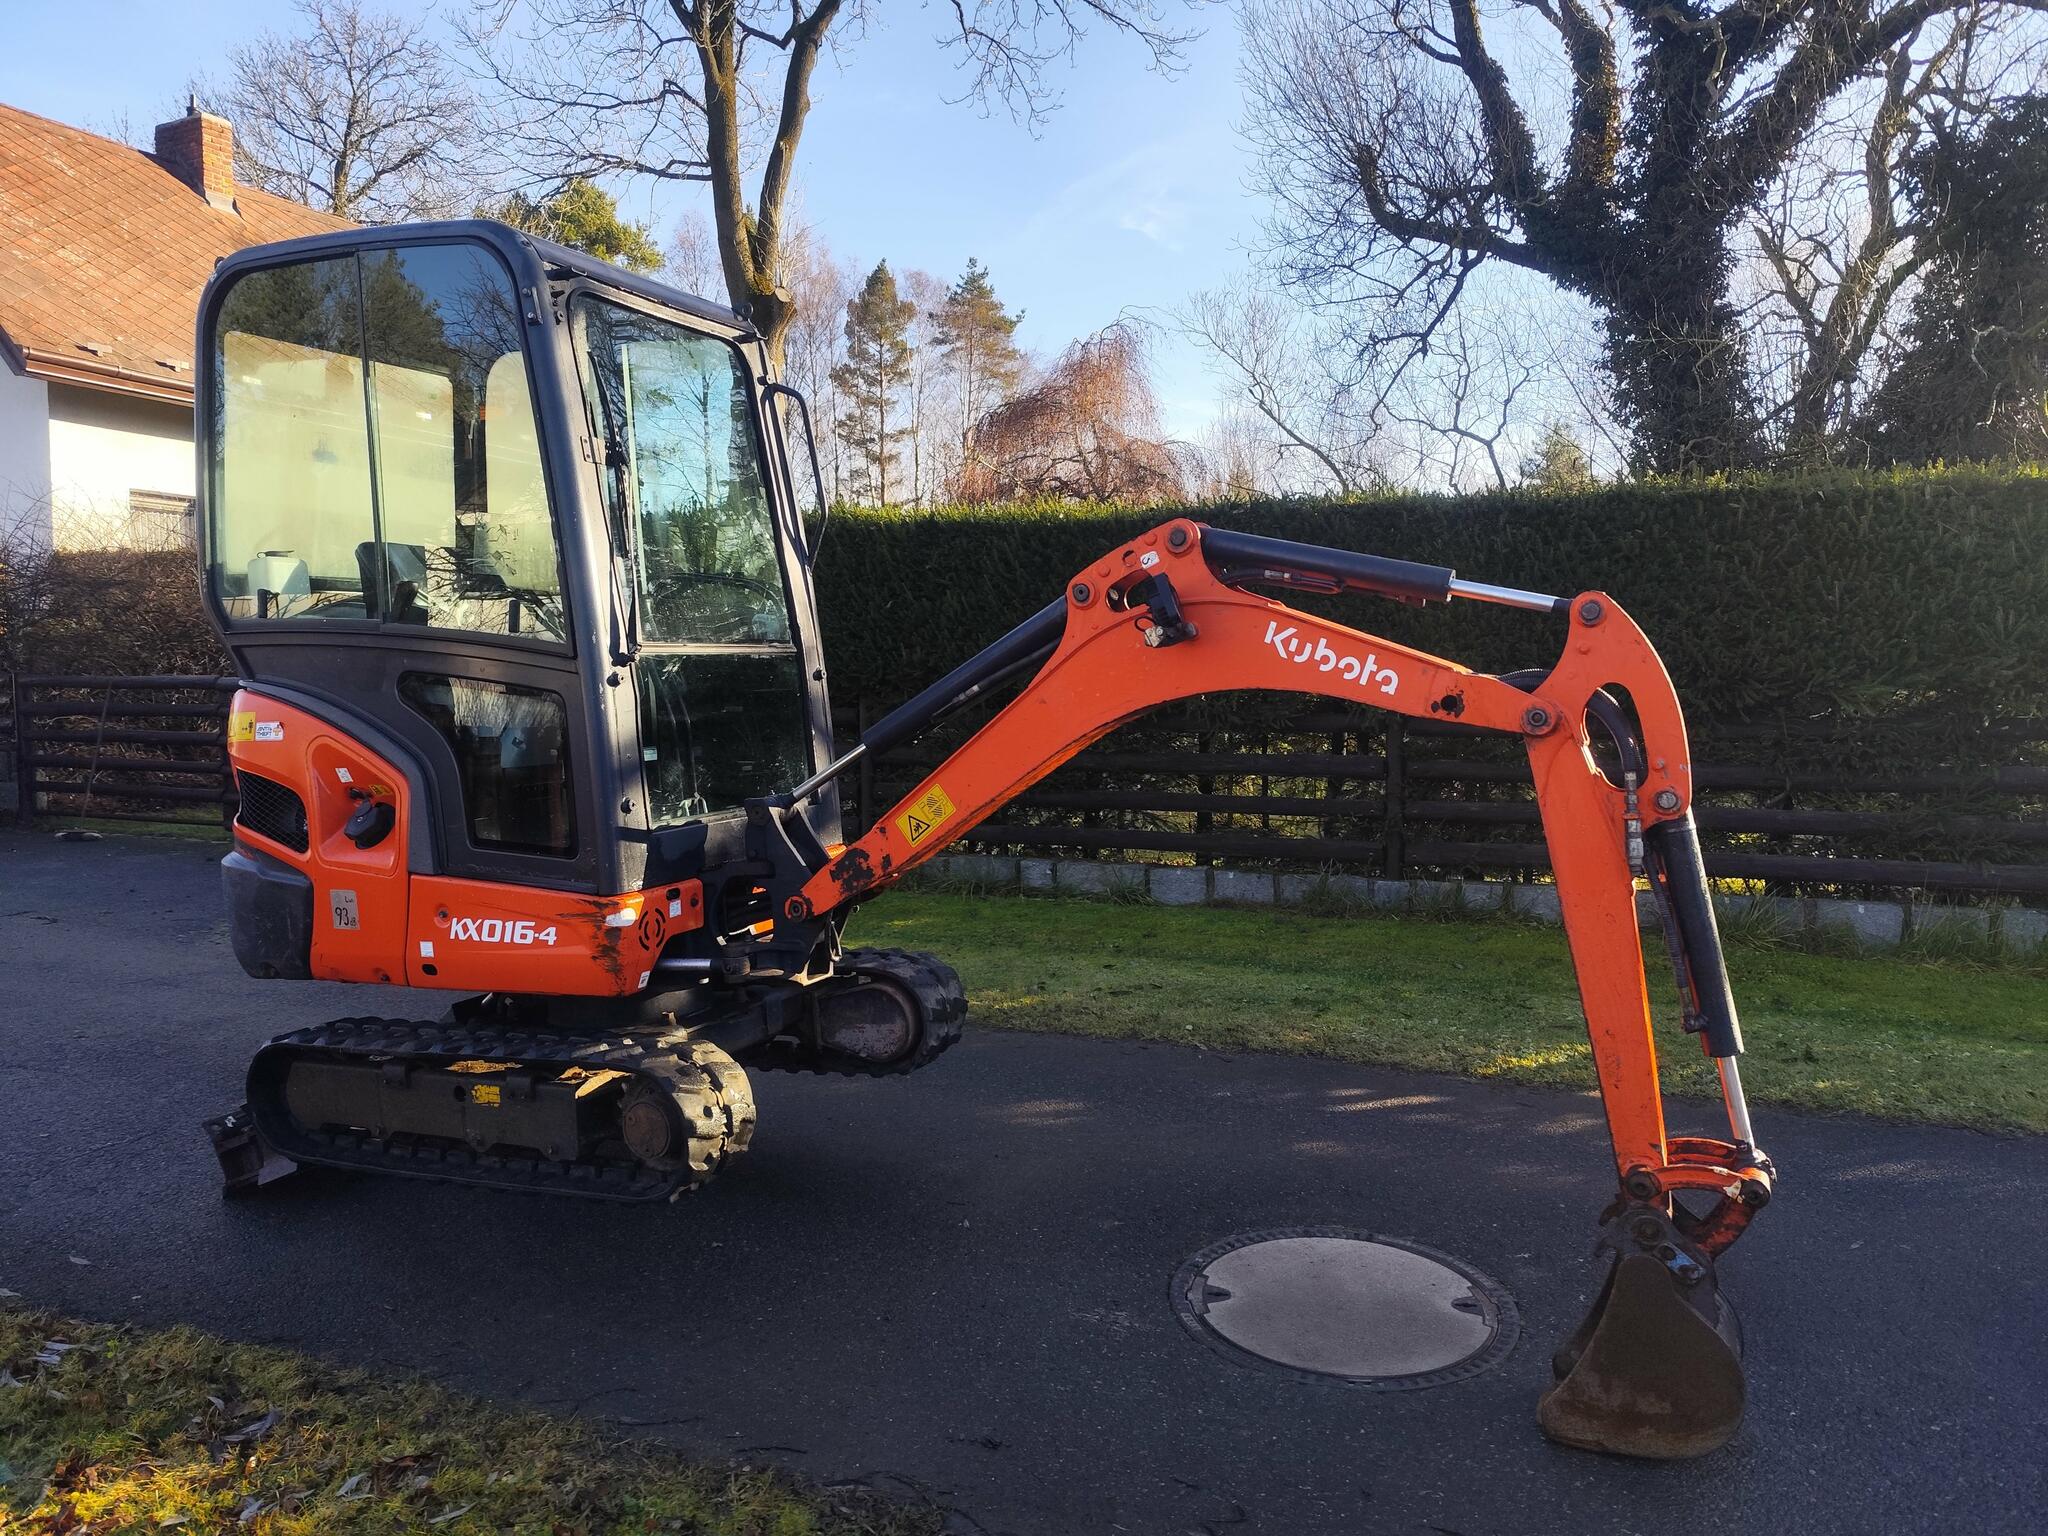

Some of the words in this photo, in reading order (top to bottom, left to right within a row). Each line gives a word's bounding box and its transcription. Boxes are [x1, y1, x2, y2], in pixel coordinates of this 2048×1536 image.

[1264, 620, 1399, 695] Kubota
[335, 906, 349, 925] 93
[449, 917, 557, 945] KX016-4
